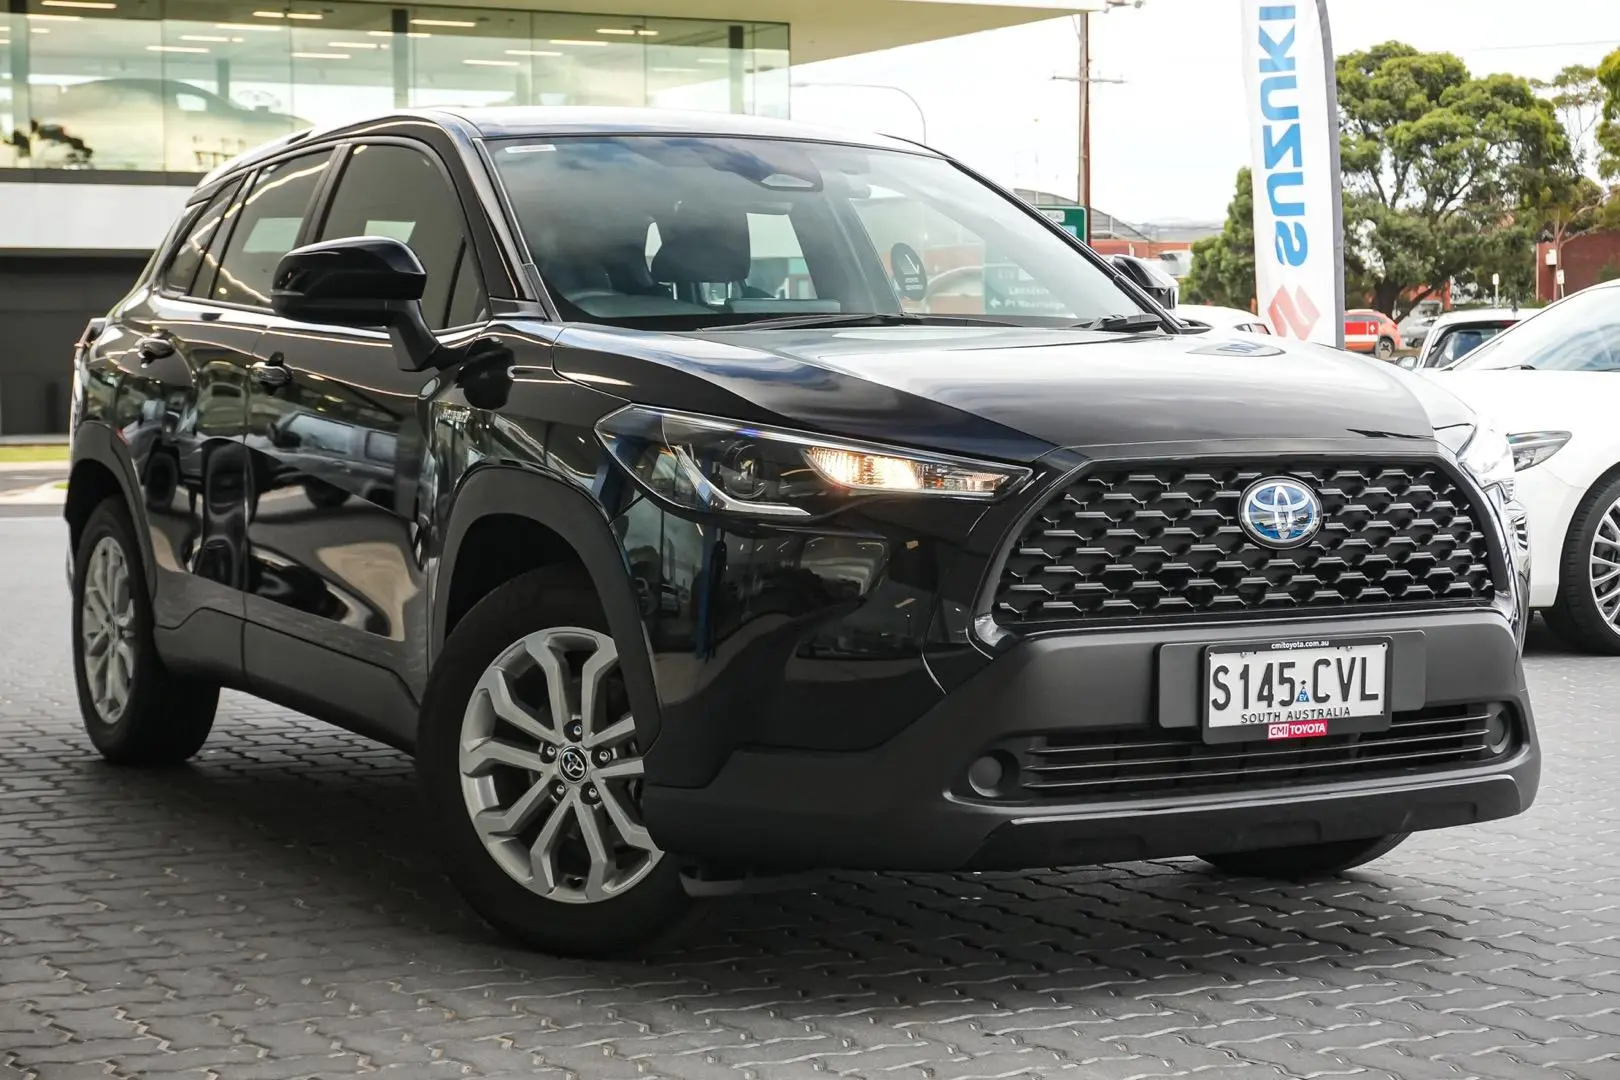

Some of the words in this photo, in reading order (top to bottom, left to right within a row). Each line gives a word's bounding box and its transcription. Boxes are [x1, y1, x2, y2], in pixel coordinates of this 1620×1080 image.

[1271, 640, 1329, 650] cmitoyota.com.au
[1241, 712, 1281, 723] SOUTH
[1286, 706, 1351, 720] AUSTRALIA
[1270, 726, 1288, 736] CMI
[1290, 723, 1326, 735] TOYOTA
